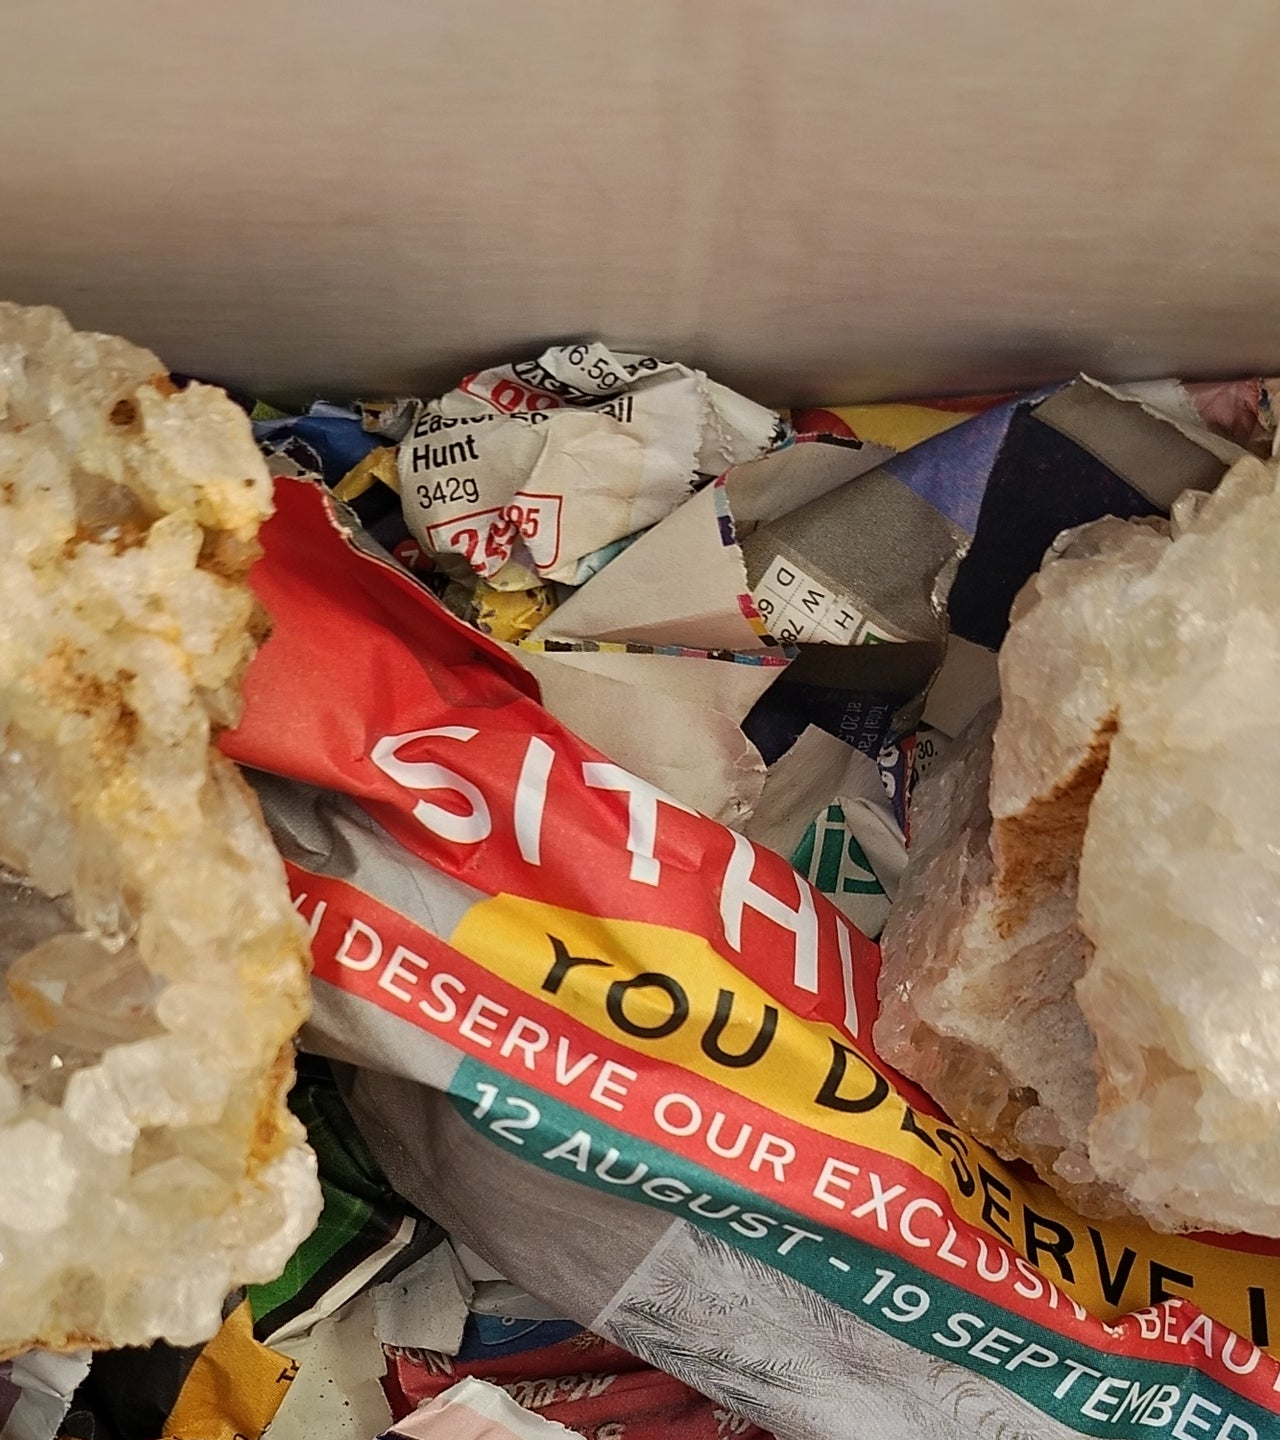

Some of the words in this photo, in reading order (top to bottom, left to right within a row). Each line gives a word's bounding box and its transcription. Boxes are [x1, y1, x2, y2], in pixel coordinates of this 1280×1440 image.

[558, 343, 620, 391] 6.5g
[411, 433, 480, 474] Hunt
[417, 476, 480, 510] 342g
[775, 566, 796, 588] D
[543, 930, 780, 1069] YOU
[334, 918, 639, 1113] DESERVE
[652, 1091, 796, 1184] OUR
[809, 1155, 1126, 1340] EXCLUSIV
[470, 1078, 543, 1148] 12
[542, 1129, 827, 1258] AUGUST
[861, 1266, 931, 1324] 19
